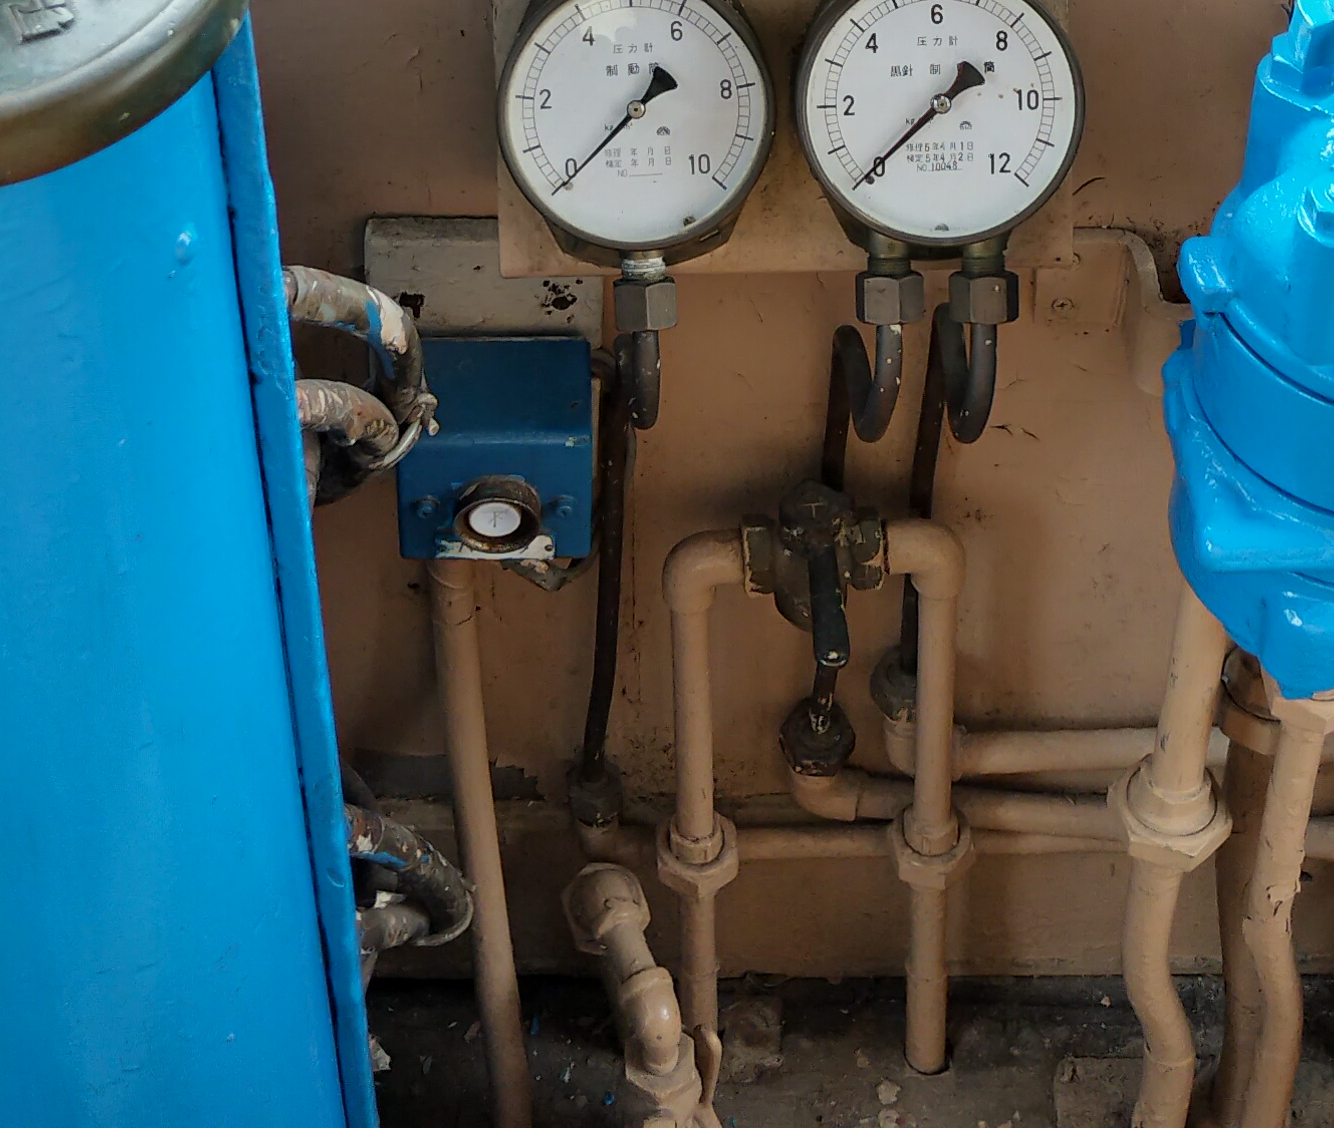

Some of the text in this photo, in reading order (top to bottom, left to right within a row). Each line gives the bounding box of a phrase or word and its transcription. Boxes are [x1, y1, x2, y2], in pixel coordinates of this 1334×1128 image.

[930, 5, 944, 25] 6
[582, 26, 596, 47] 4
[670, 21, 683, 41] 6
[995, 30, 1009, 51] 8
[865, 32, 879, 53] 4
[539, 89, 552, 109] 2
[720, 79, 732, 100] 8
[1016, 89, 1040, 111] 10
[842, 95, 855, 116] 2
[565, 158, 578, 179] 0
[688, 153, 712, 176] 10
[873, 157, 886, 178] 0
[988, 153, 1013, 175] 12
